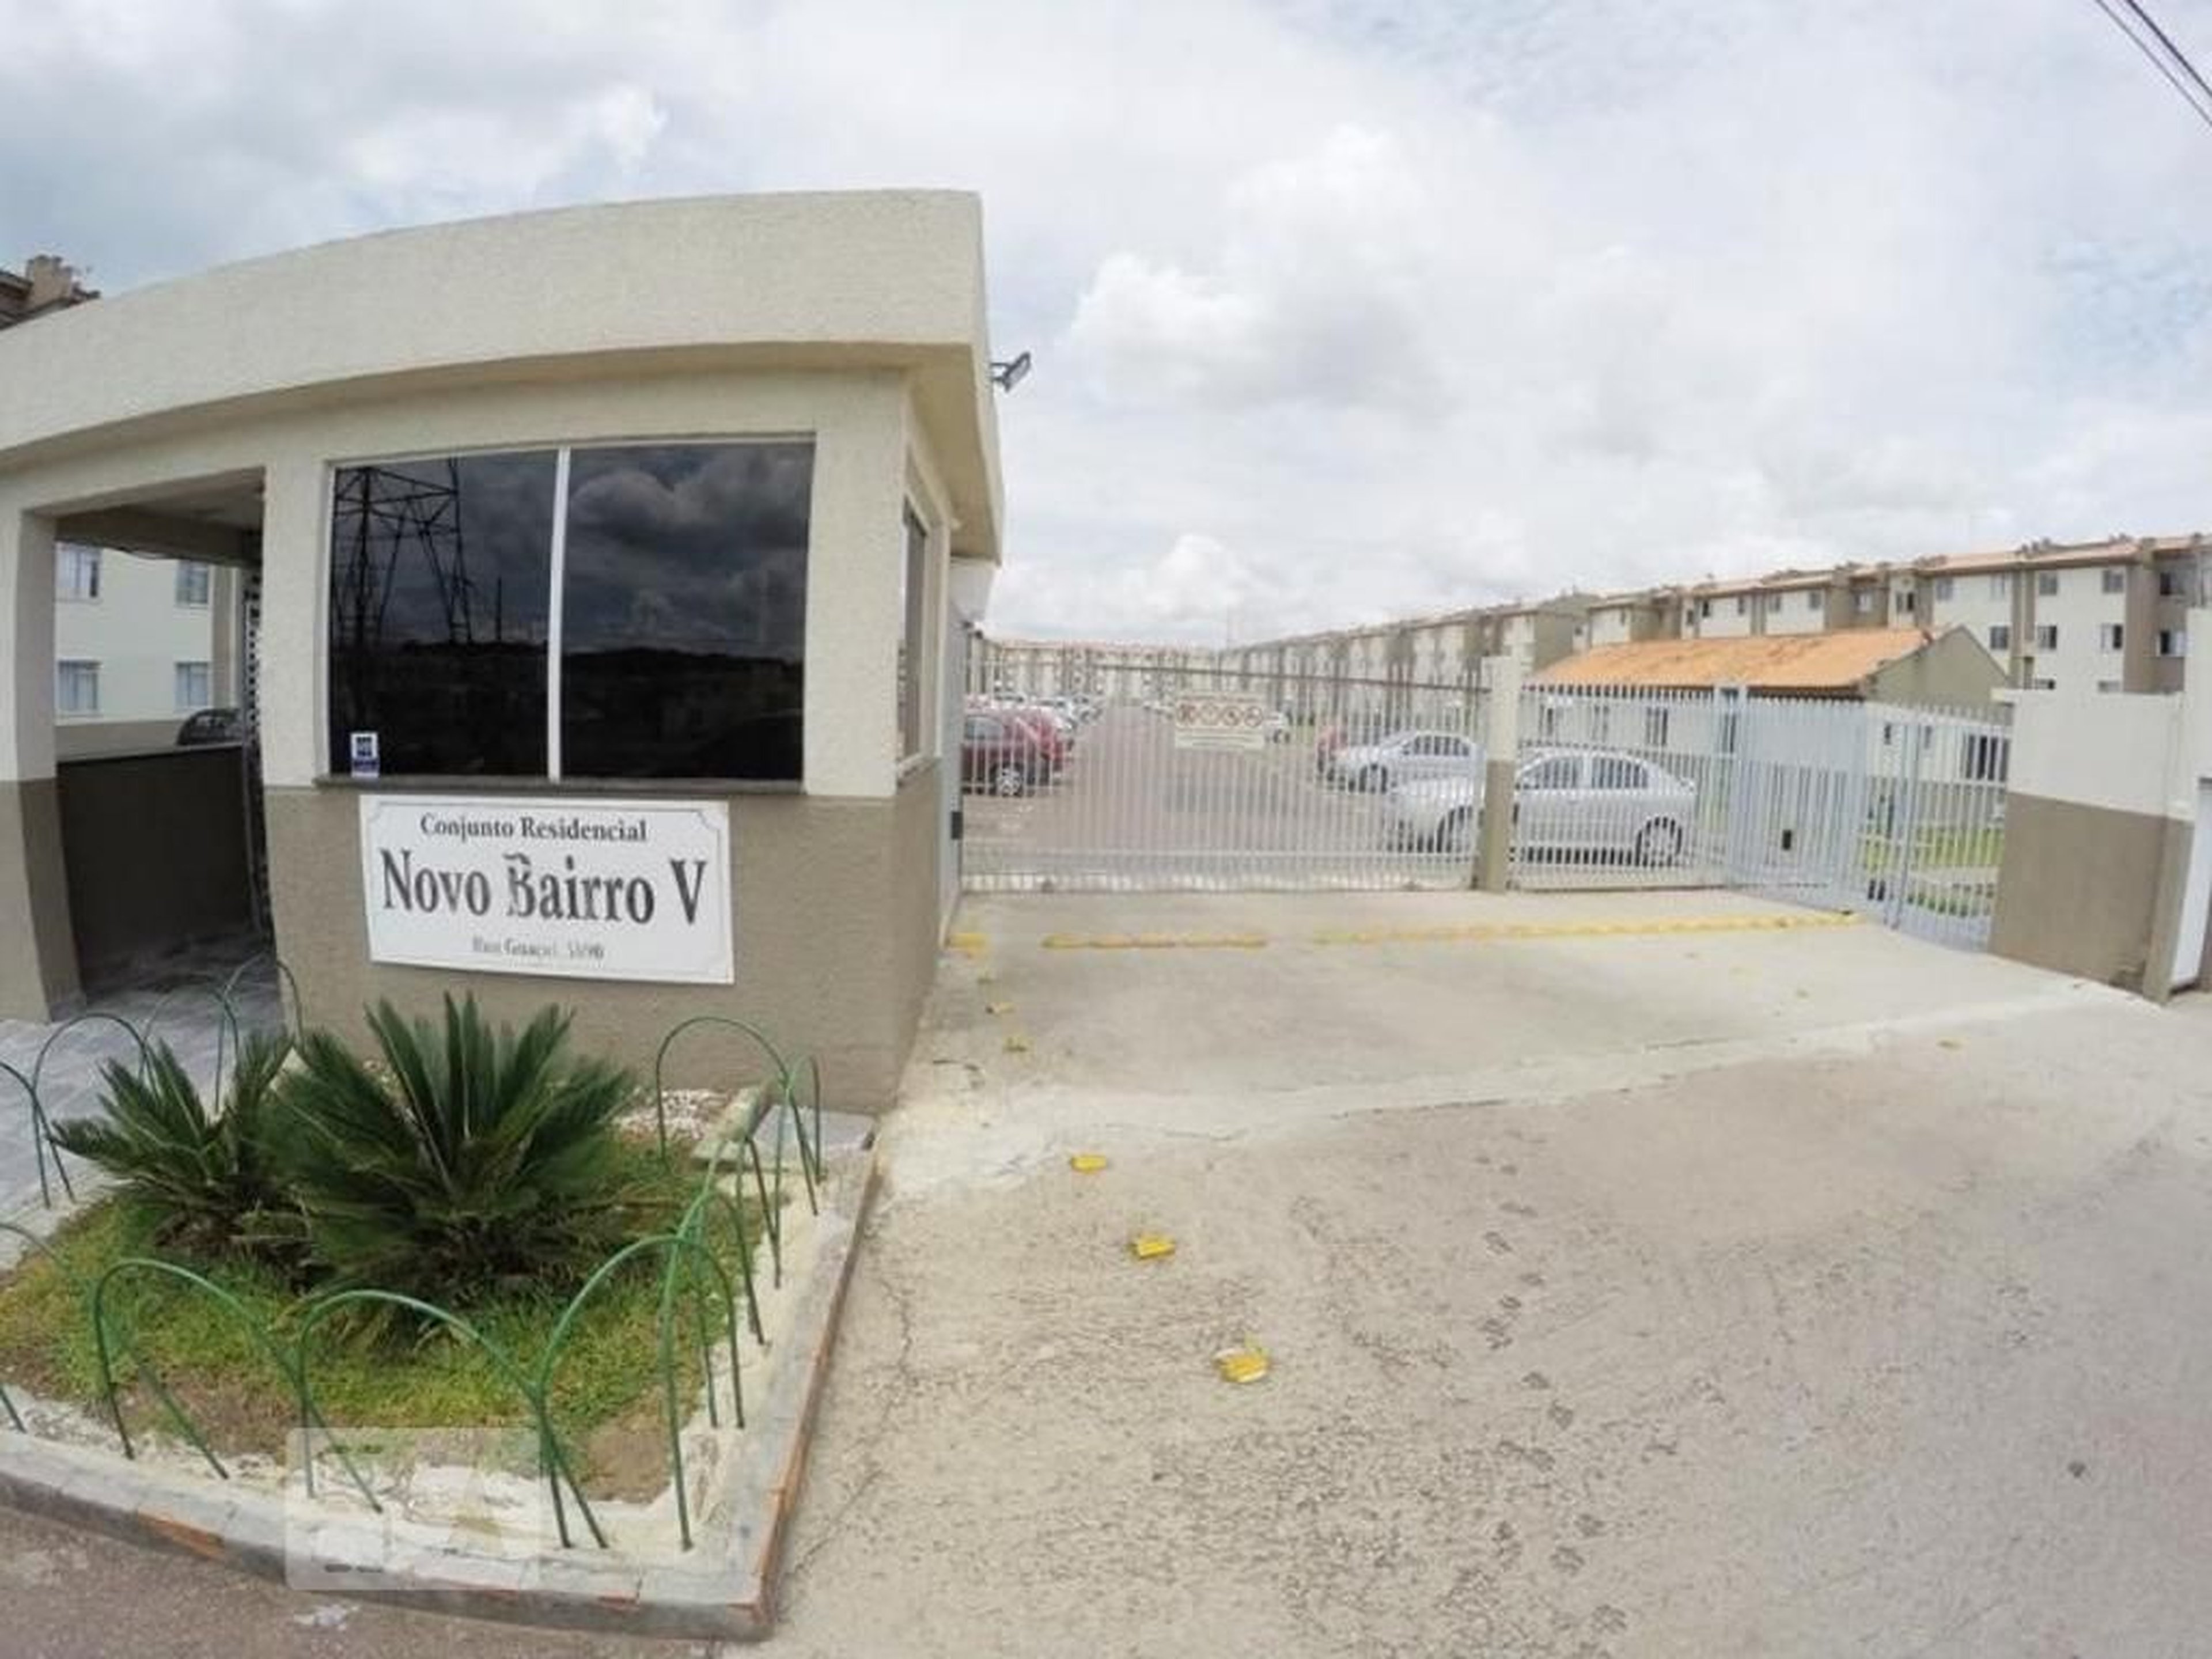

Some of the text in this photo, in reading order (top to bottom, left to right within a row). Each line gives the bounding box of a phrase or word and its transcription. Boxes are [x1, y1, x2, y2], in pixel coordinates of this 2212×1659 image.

[420, 813, 647, 843] Conjunto Residencial
[380, 847, 706, 925] Novo Bairro V
